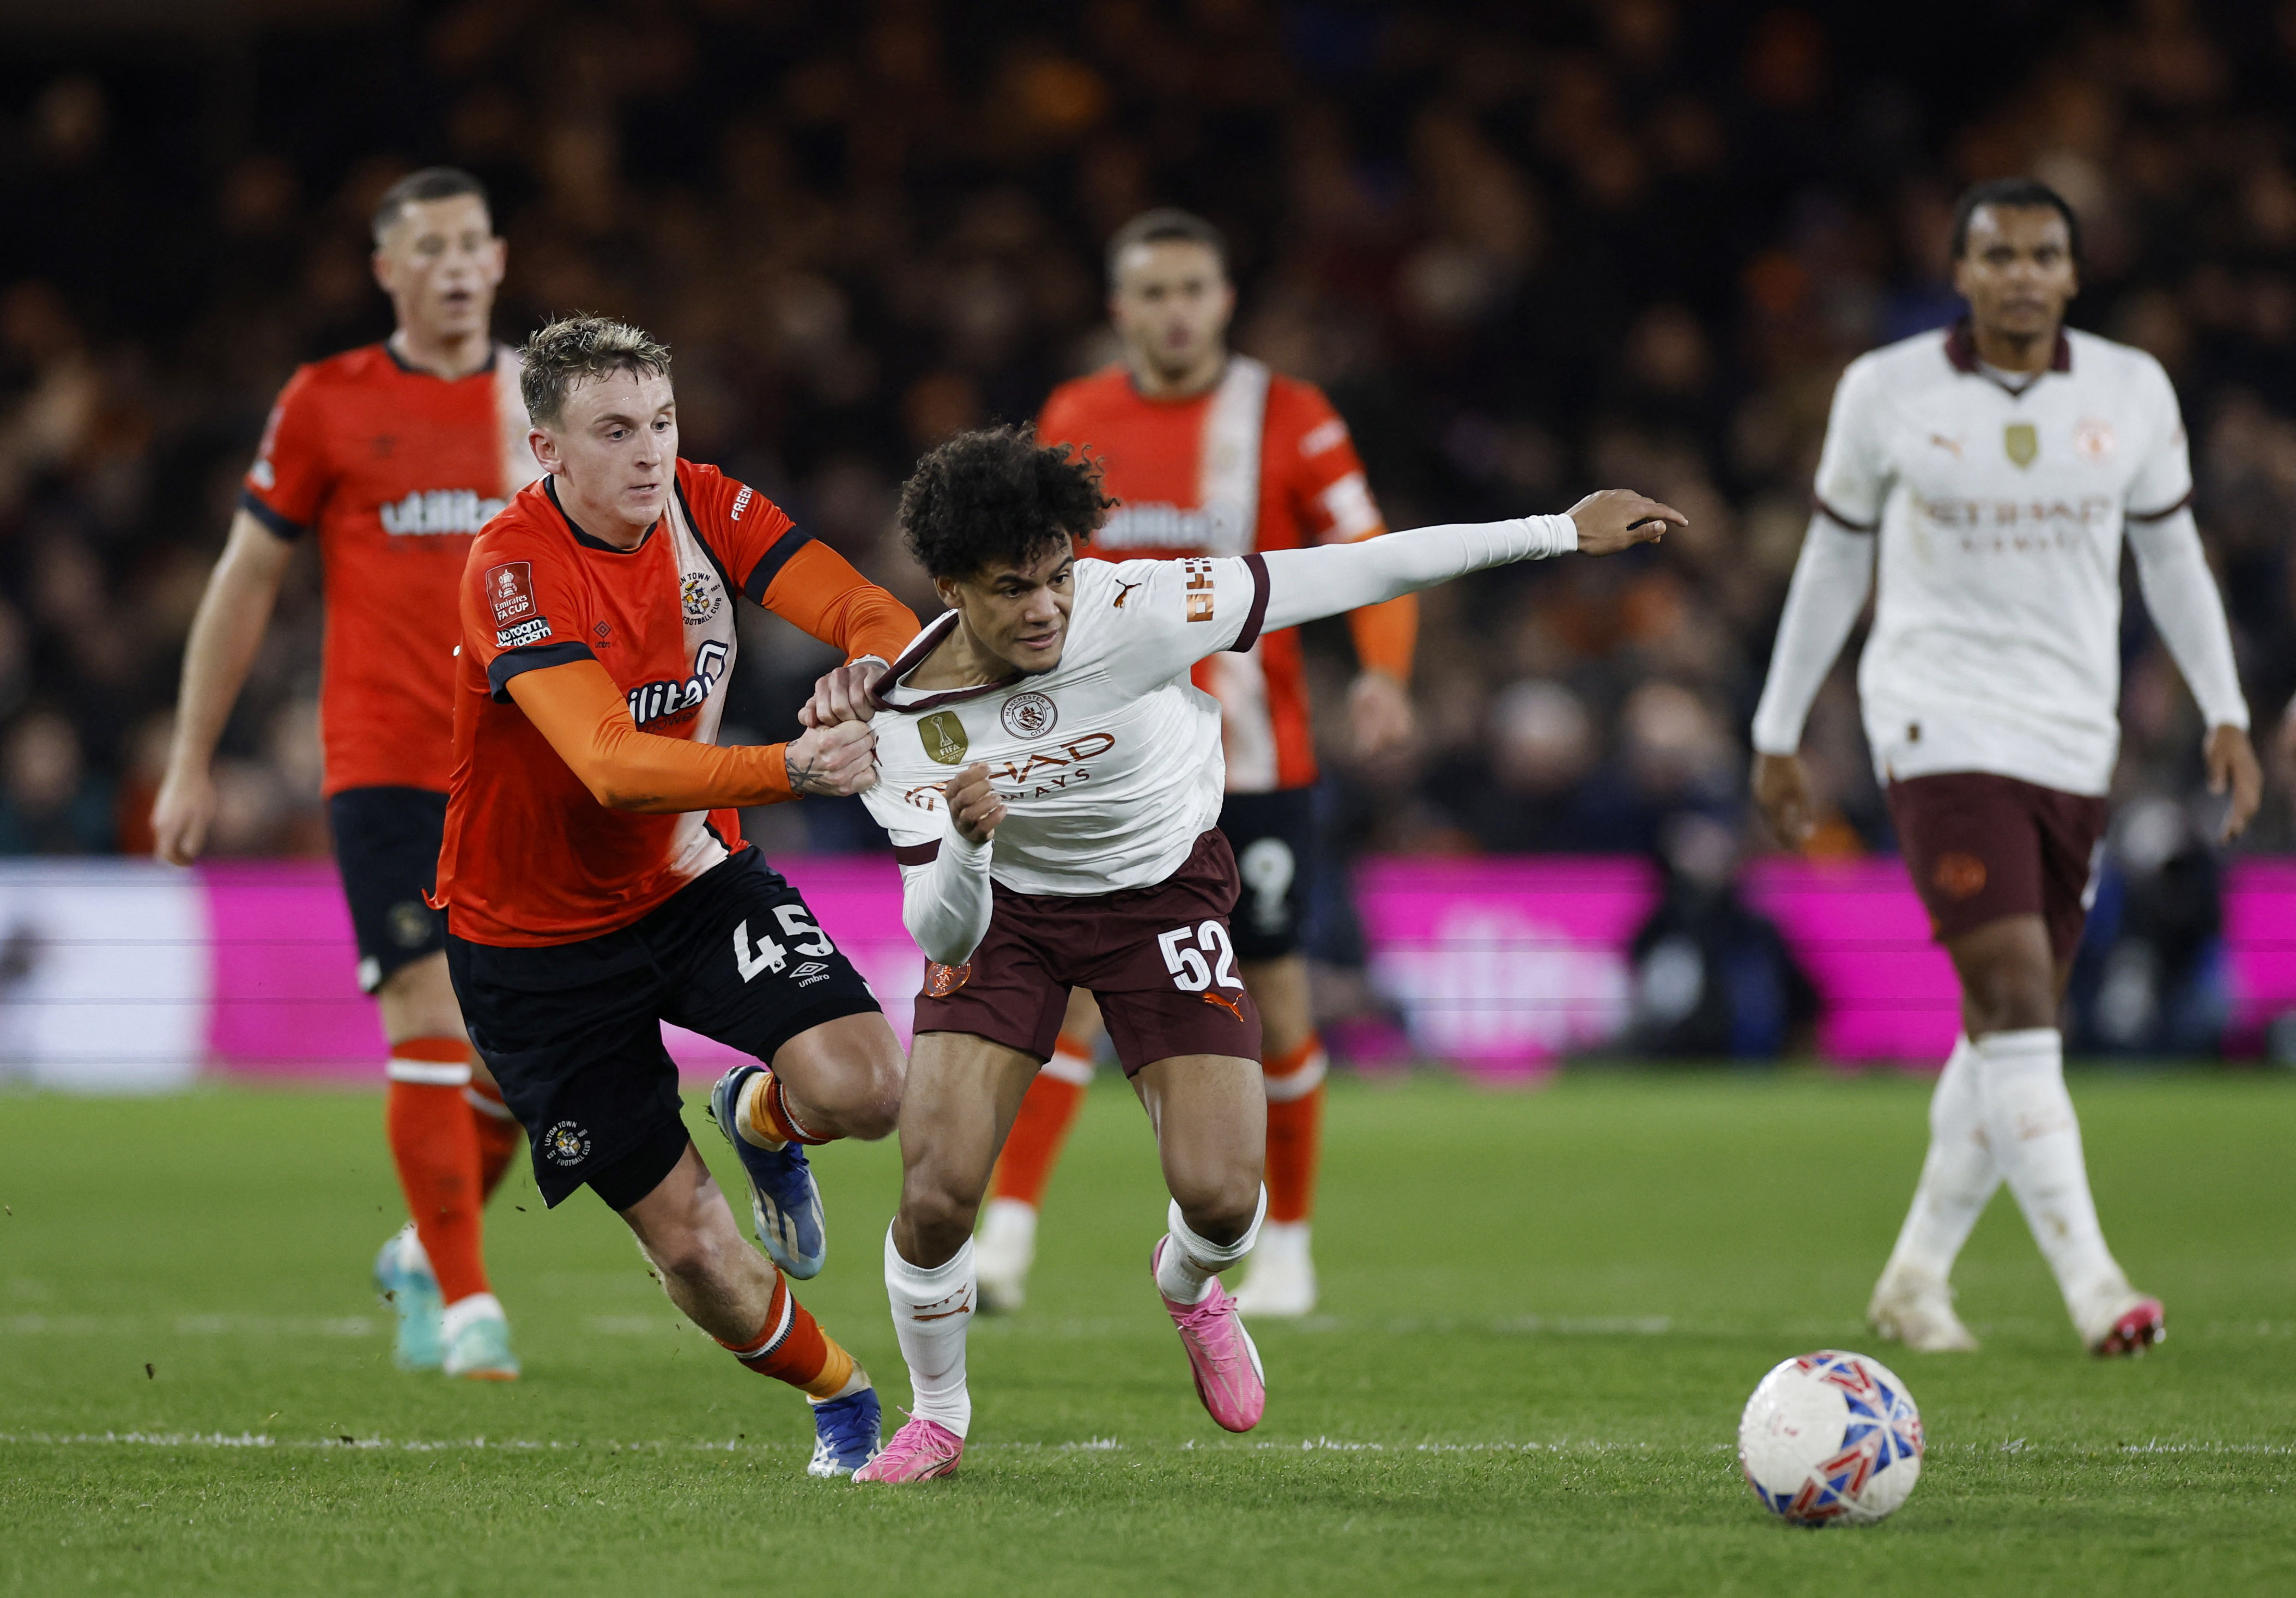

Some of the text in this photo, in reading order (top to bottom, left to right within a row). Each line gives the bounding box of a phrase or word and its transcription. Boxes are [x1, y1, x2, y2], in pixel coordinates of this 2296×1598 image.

[687, 572, 711, 581] TOWN
[495, 594, 528, 611] Emirates
[497, 601, 529, 621] FA CUP
[682, 597, 722, 625] FOOTBALL CLUB
[496, 619, 543, 643] No room
[513, 627, 552, 647] racism
[1005, 695, 1045, 716] MANCHESTER
[1031, 727, 1045, 737] CITY
[940, 744, 960, 756] FIFA
[733, 904, 834, 984] 45
[1157, 920, 1245, 992] 52
[798, 974, 830, 988] umbro
[544, 1120, 577, 1146] LUTON TOWN
[547, 1150, 556, 1159] EST
[556, 1140, 591, 1166] FOOTBALL CLUB
